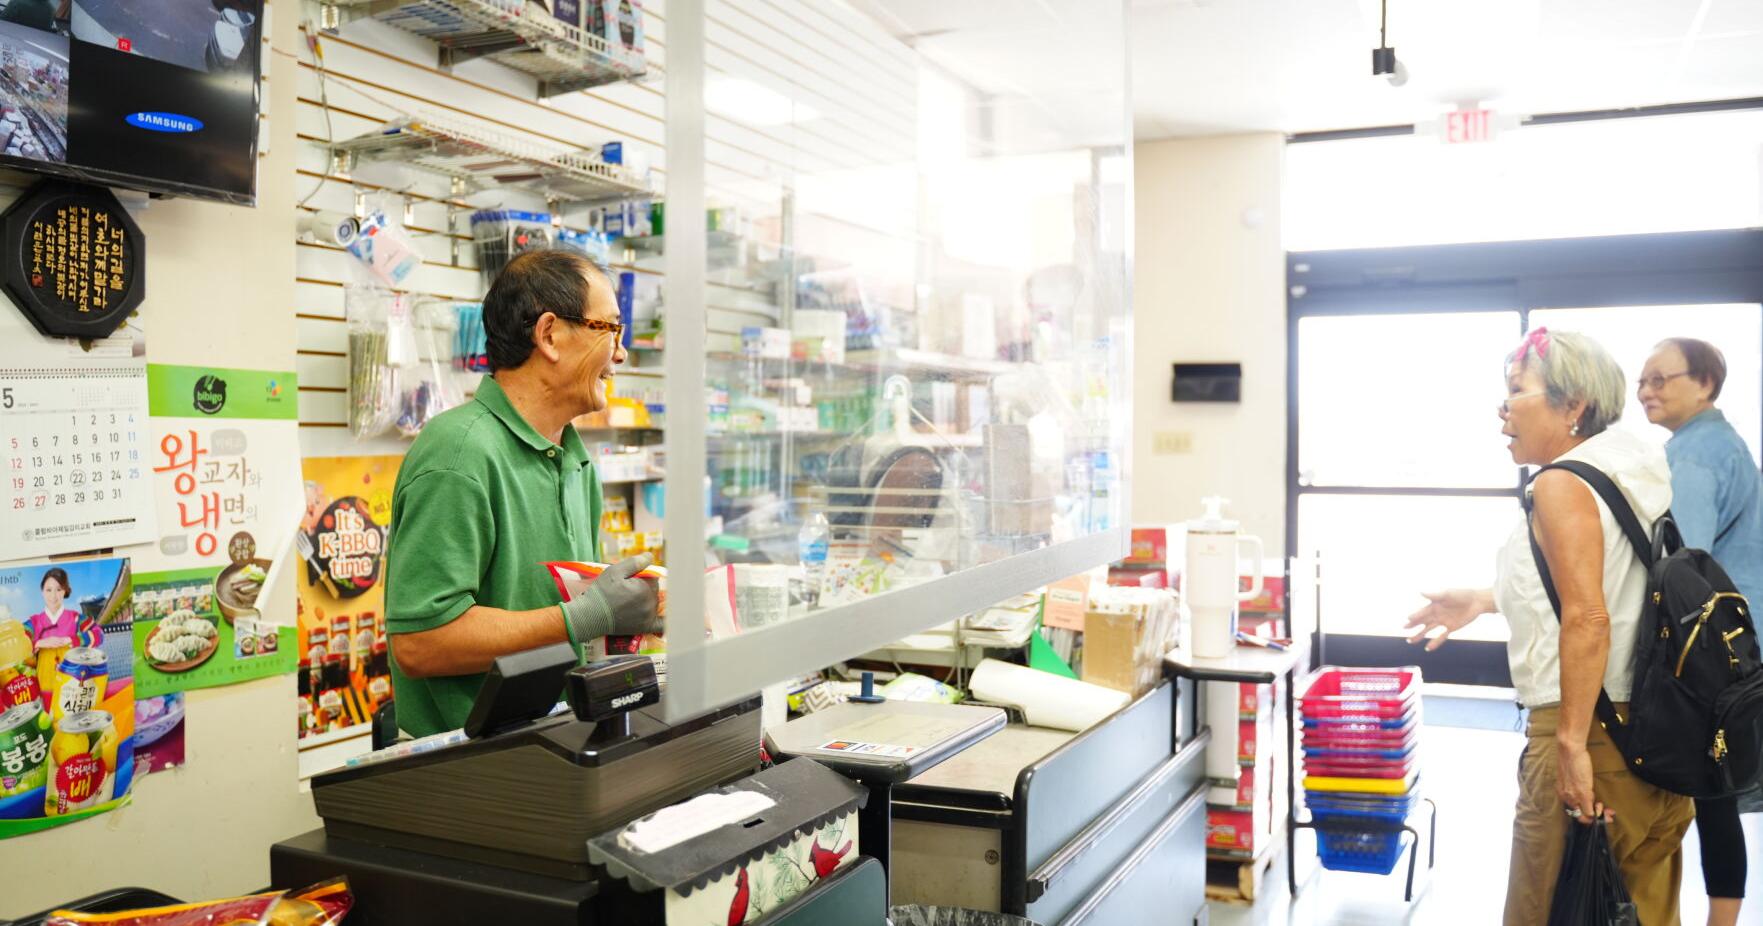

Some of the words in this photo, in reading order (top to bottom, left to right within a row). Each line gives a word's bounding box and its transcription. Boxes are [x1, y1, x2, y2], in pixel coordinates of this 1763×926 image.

[137, 112, 194, 132] SAMSUNG
[1447, 110, 1491, 143] EXIT
[3, 388, 14, 408] 5
[198, 390, 222, 404] bibigo
[72, 416, 76, 426] 1
[91, 415, 96, 425] 2
[110, 414, 115, 424] 3
[129, 414, 134, 423] 4
[11, 438, 18, 448] 5
[32, 437, 38, 447] 6
[53, 436, 59, 446] 7
[72, 435, 78, 445] 8
[92, 434, 97, 444] 9
[110, 433, 119, 442] 10
[128, 432, 136, 441] 11
[11, 459, 22, 469] 12
[32, 457, 42, 467] 13
[53, 456, 63, 466] 14
[72, 455, 82, 464] 15
[92, 453, 101, 463] 16
[110, 452, 120, 461] 17
[129, 450, 138, 460] 18
[13, 478, 24, 488] 19
[34, 477, 45, 487] 20
[54, 475, 63, 485] 21
[73, 473, 84, 484] 22
[92, 472, 102, 482] 23
[112, 470, 121, 480] 24
[129, 468, 139, 478] 25
[14, 499, 25, 509] 26
[35, 496, 46, 507] 27
[56, 495, 66, 504] 28
[75, 493, 85, 502] 29
[94, 491, 104, 501] 30
[112, 489, 121, 499] 31
[336, 510, 363, 531] It's
[320, 532, 380, 557] K-BBQ
[330, 558, 372, 578] time
[611, 692, 644, 709] SHARP
[1, 734, 48, 773] 봉봉
[70, 774, 91, 798] 배
